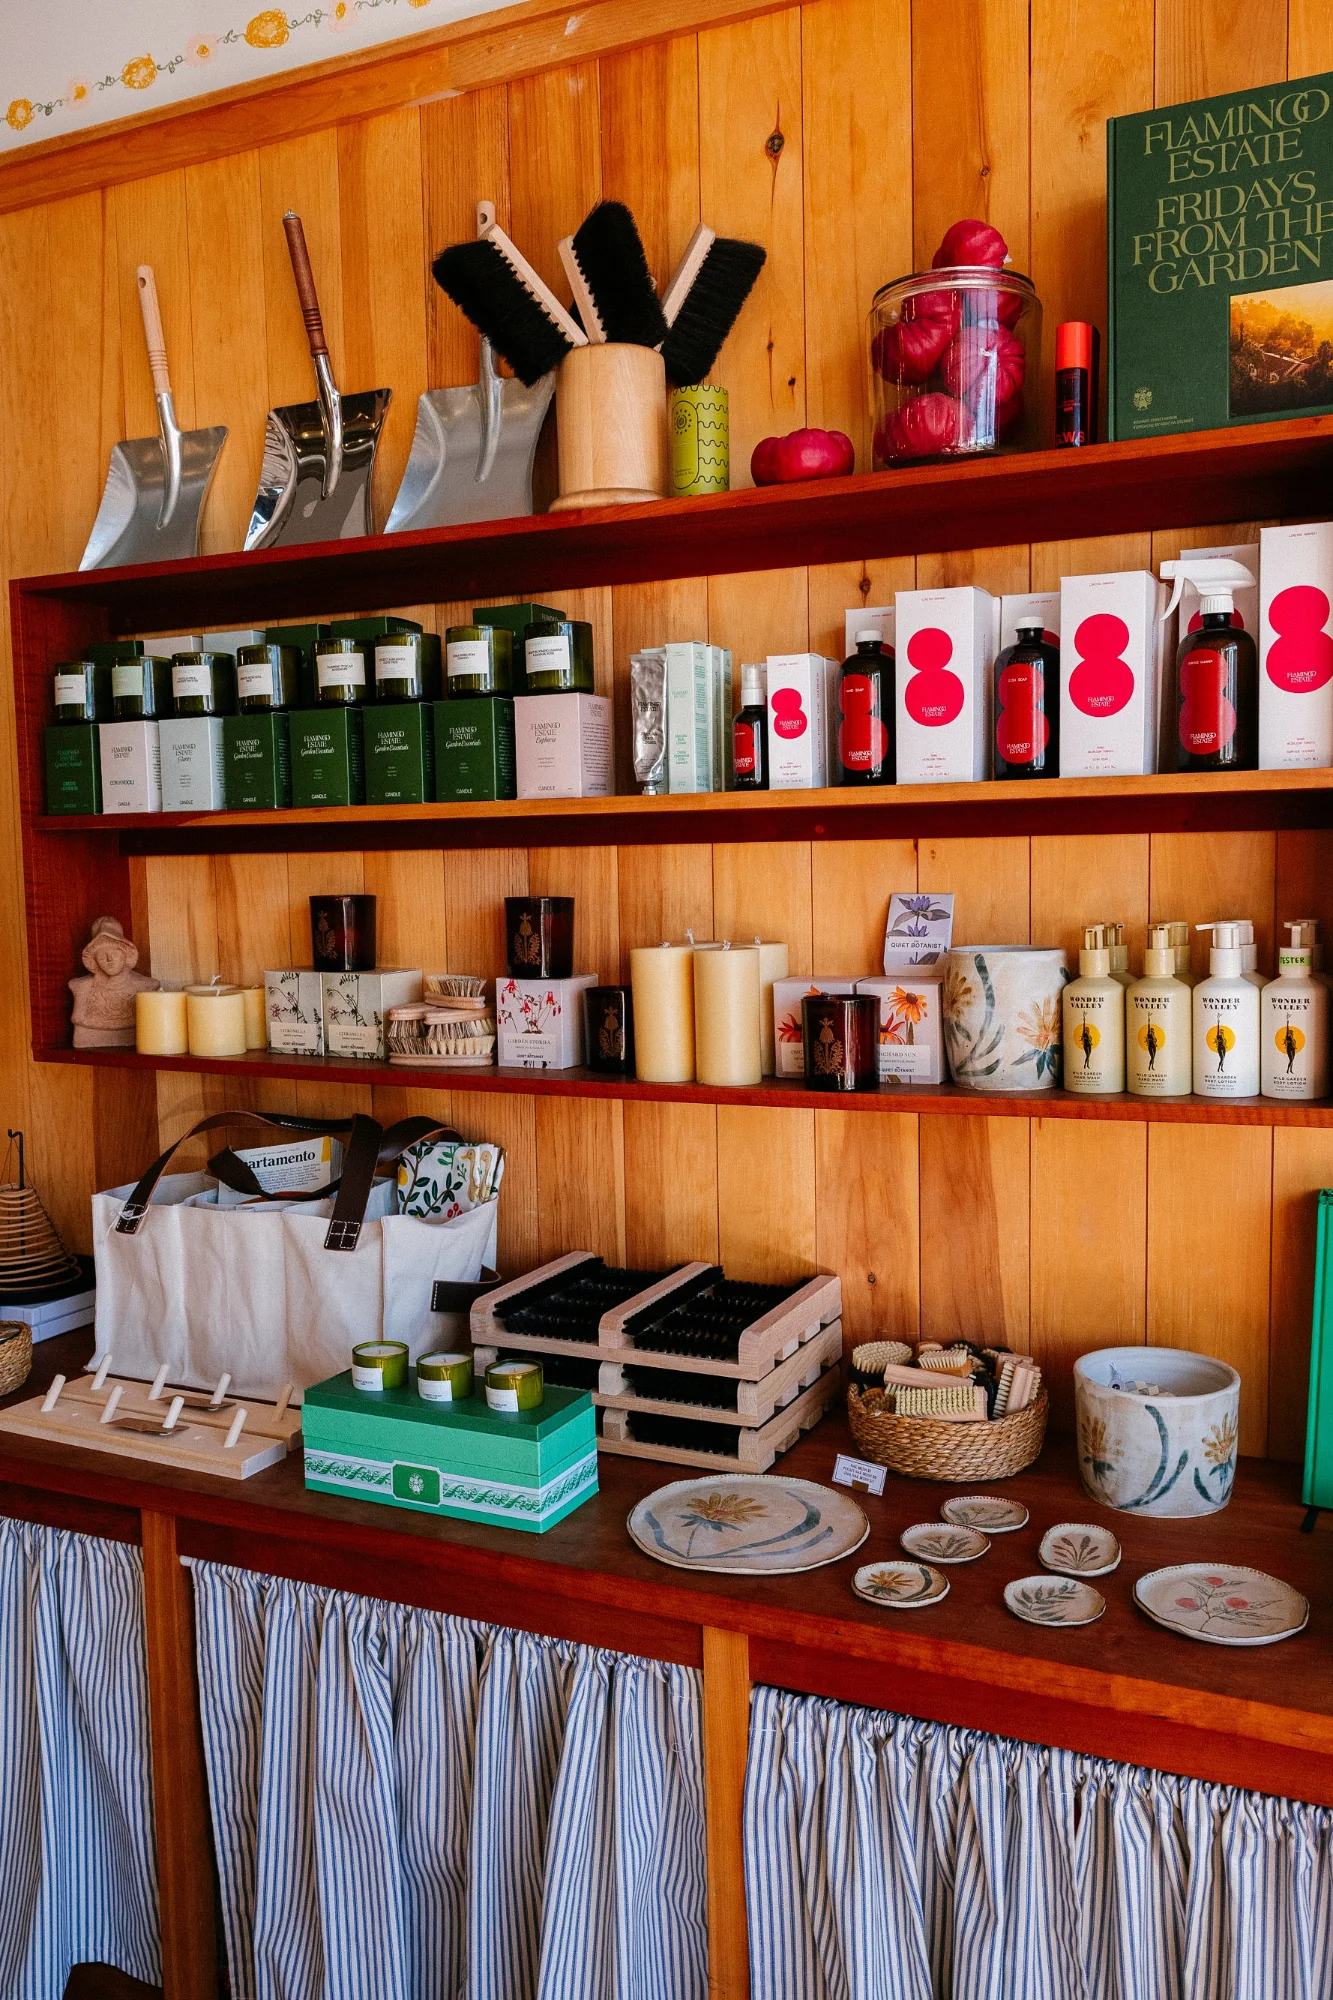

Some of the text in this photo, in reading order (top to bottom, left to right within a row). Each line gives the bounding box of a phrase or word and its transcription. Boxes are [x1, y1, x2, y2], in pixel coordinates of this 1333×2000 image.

[1144, 89, 1330, 155] FLAMINGO
[1168, 127, 1304, 184] ESTATE
[1156, 170, 1316, 229] FRIDAYS
[1133, 200, 1333, 266] FROM THE
[1148, 236, 1322, 294] GARDEN
[1287, 670, 1317, 679] FLAMINGO
[1087, 695, 1116, 703] FLAMINGO
[587, 702, 604, 711] FLAMINGO
[921, 706, 947, 714] FLAMINGO
[590, 710, 603, 718] ESTATE
[530, 722, 562, 731] FLAMINGO
[778, 719, 802, 727] FLAMINGO
[378, 730, 405, 740] FLAMINGO
[449, 726, 478, 735] FLAMINGO
[303, 734, 331, 743] FLAMINGO
[534, 736, 557, 744] Euphoria
[1190, 732, 1216, 741] FLAMINGO
[236, 738, 260, 747] FLAMINGO
[380, 737, 402, 746] ESTATE
[445, 739, 482, 750] Garden Essentials
[1006, 742, 1031, 750] FLAMINGO
[111, 746, 133, 754] FLAMINGO
[300, 746, 336, 758] Garden Essentials
[374, 743, 410, 754] Garden Essentials
[848, 750, 874, 758] FLAMINGO
[1280, 956, 1305, 964] TESTER
